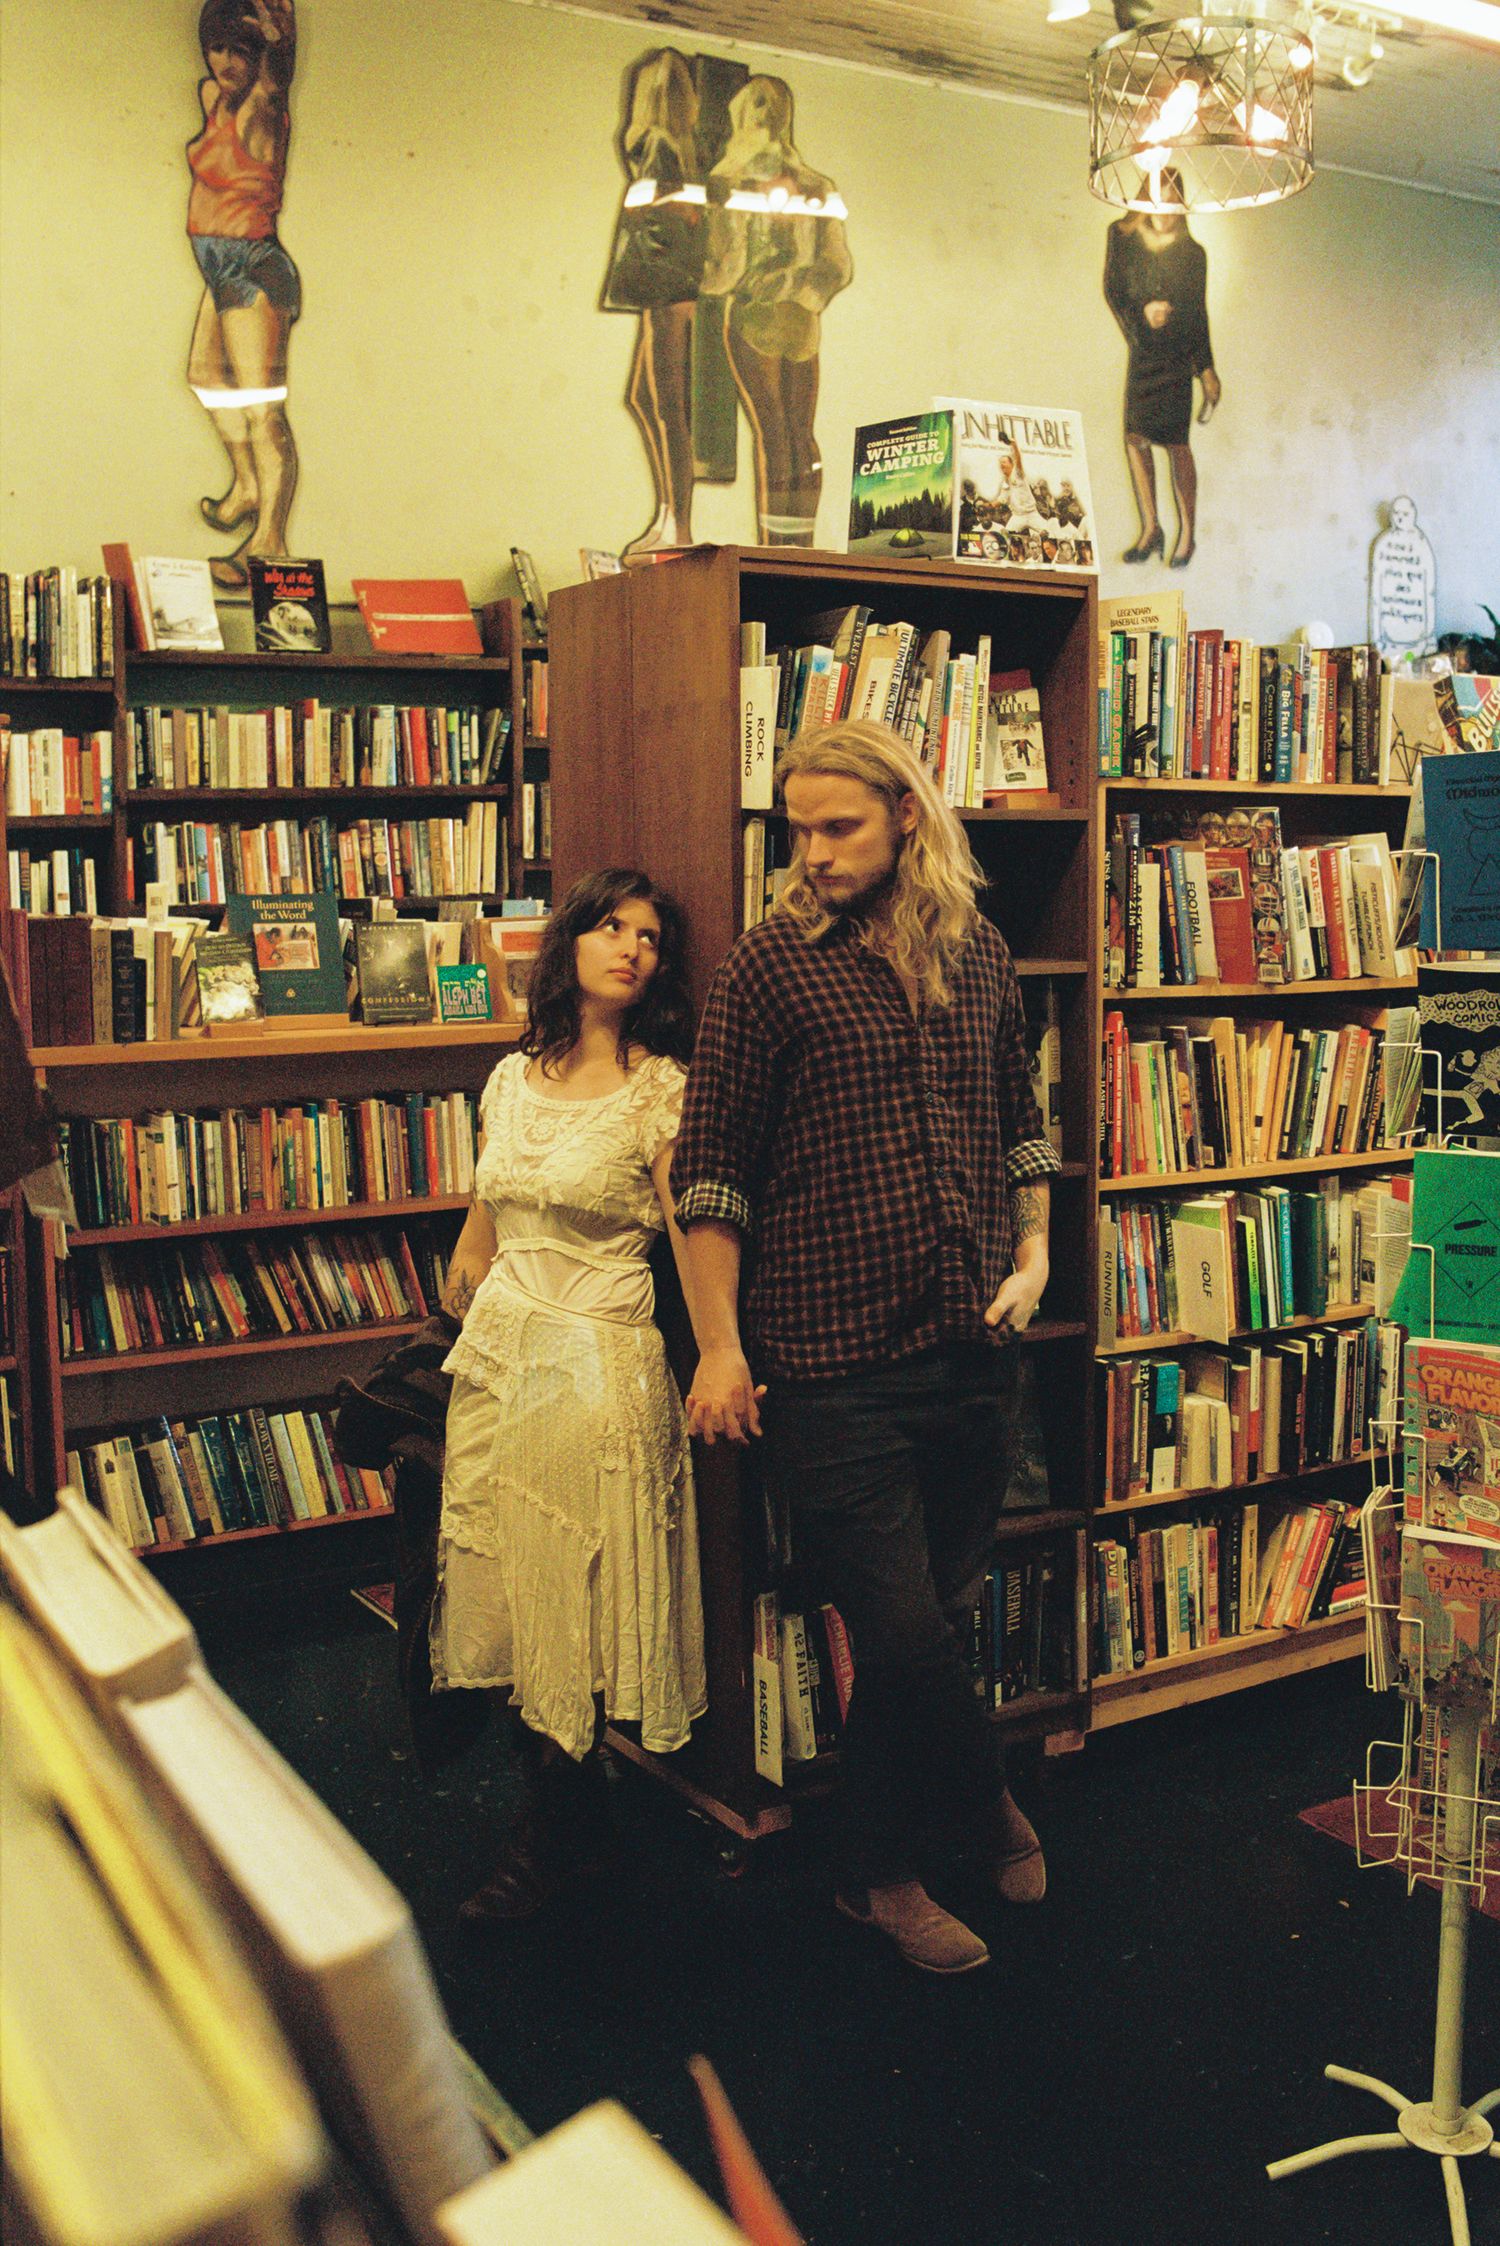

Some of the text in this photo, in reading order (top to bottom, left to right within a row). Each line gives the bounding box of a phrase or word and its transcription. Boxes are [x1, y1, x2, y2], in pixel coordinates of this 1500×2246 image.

[866, 436, 904, 449] COMPLETE
[905, 432, 929, 441] GUIDE
[866, 439, 939, 462] WINTER
[860, 450, 945, 476] CAMPING
[1110, 616, 1159, 627] BASEBALL STARS
[1116, 607, 1152, 618] LEGENDARY
[849, 621, 865, 668] EVEREST
[884, 631, 909, 723] ULTIMATE BICYCLE
[956, 663, 965, 686] MAGIC
[815, 678, 830, 720] KILLI
[862, 680, 877, 719] BIKES
[954, 689, 964, 720] SPANNER
[977, 684, 985, 704] BICYCLE
[976, 705, 984, 742] MAINTENANCE
[1112, 664, 1122, 767] MIND GAME
[1265, 684, 1274, 760] CONNIE MACK
[1280, 690, 1291, 738] BIG FELLA
[744, 701, 753, 778] CLIMBING
[756, 717, 765, 761] ROCK
[1104, 851, 1112, 881] SOSA
[1309, 856, 1319, 891] WAR
[252, 900, 315, 912] Illuminating
[260, 910, 307, 920] the Word
[1128, 900, 1136, 926] ZIM
[1186, 882, 1202, 947] FOOTBALL
[1361, 891, 1374, 950] TUMBLE/PUNCH
[1135, 885, 1144, 972] BASKETBALL
[1379, 953, 1385, 961] &
[361, 995, 430, 1005] CONFESSIONS
[442, 985, 486, 1007] ALEPH BET
[1453, 1012, 1500, 1024] COMICS
[1282, 1212, 1290, 1236] GOLF
[1444, 1243, 1497, 1257] PRESSURE
[1104, 1250, 1113, 1317] RUNNING
[1201, 1261, 1212, 1299] GOLF
[1421, 1364, 1500, 1396] ORANG
[256, 1417, 279, 1483] DOWN HOME
[1006, 1570, 1021, 1635] BASEBALL
[794, 1632, 809, 1698] 42 FAITH
[833, 1622, 854, 1703] CHARLIE HUS
[759, 1679, 769, 1756] BASEBALL
